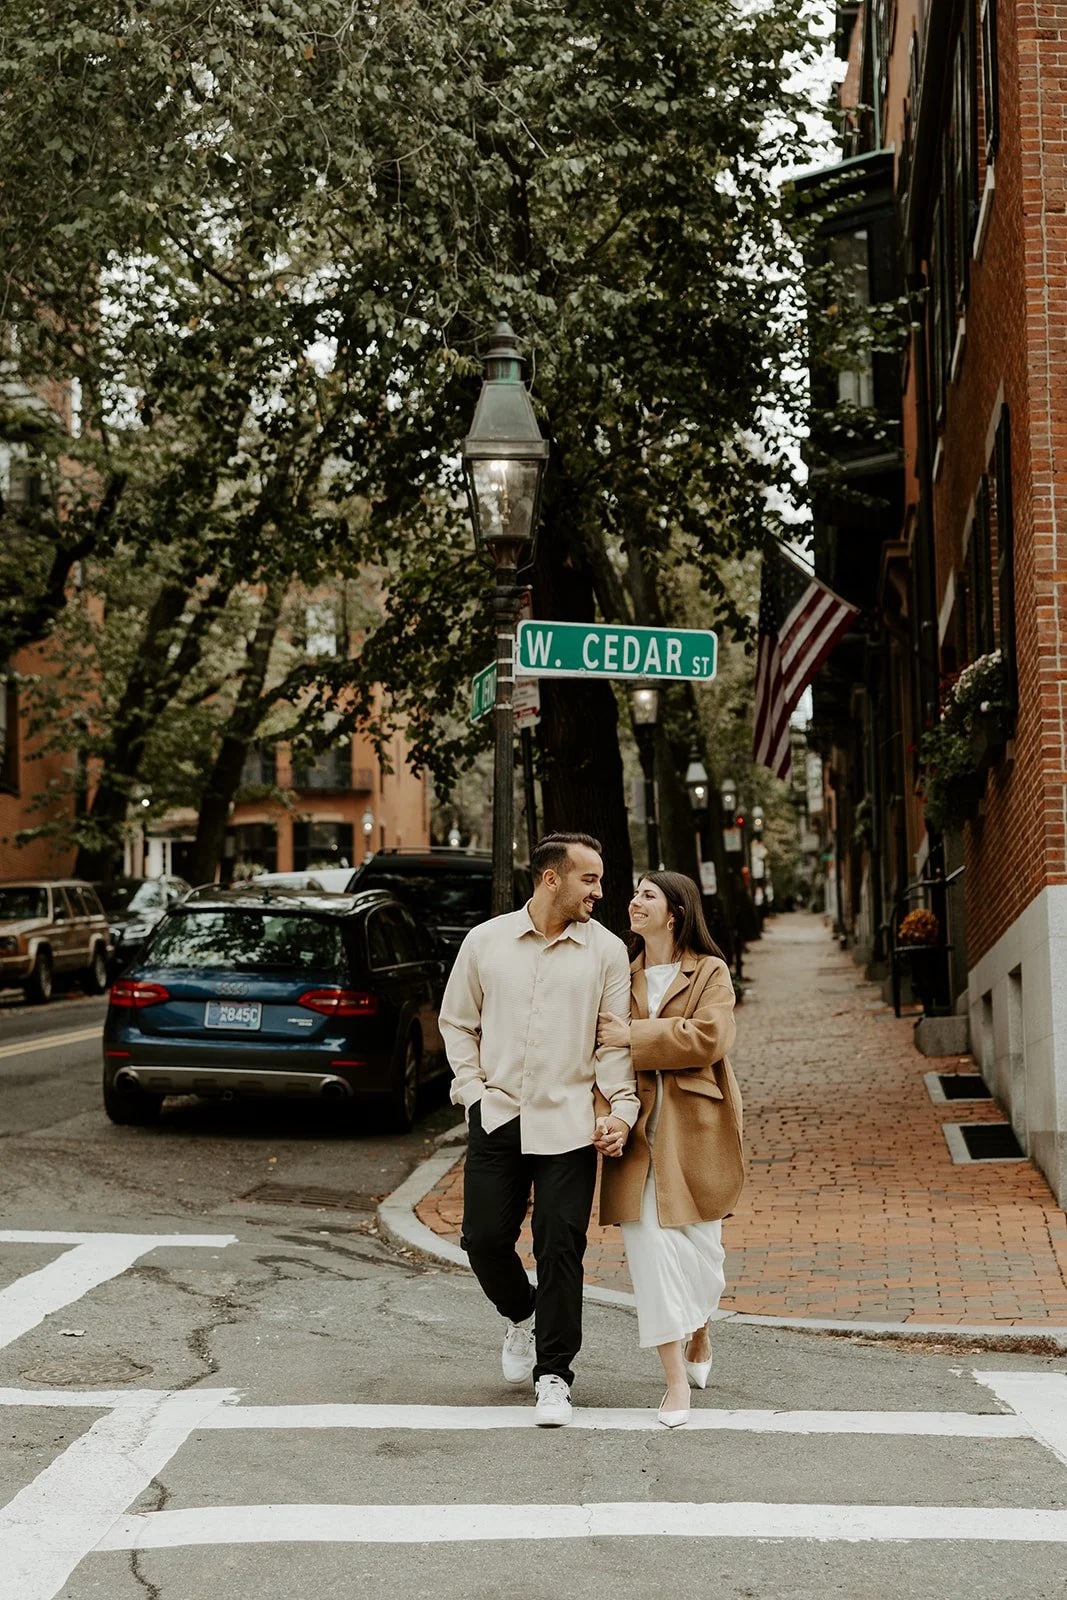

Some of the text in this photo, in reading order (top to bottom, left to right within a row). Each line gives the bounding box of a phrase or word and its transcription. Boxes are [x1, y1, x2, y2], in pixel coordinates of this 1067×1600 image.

[526, 630, 710, 676] W. CEDAR ST
